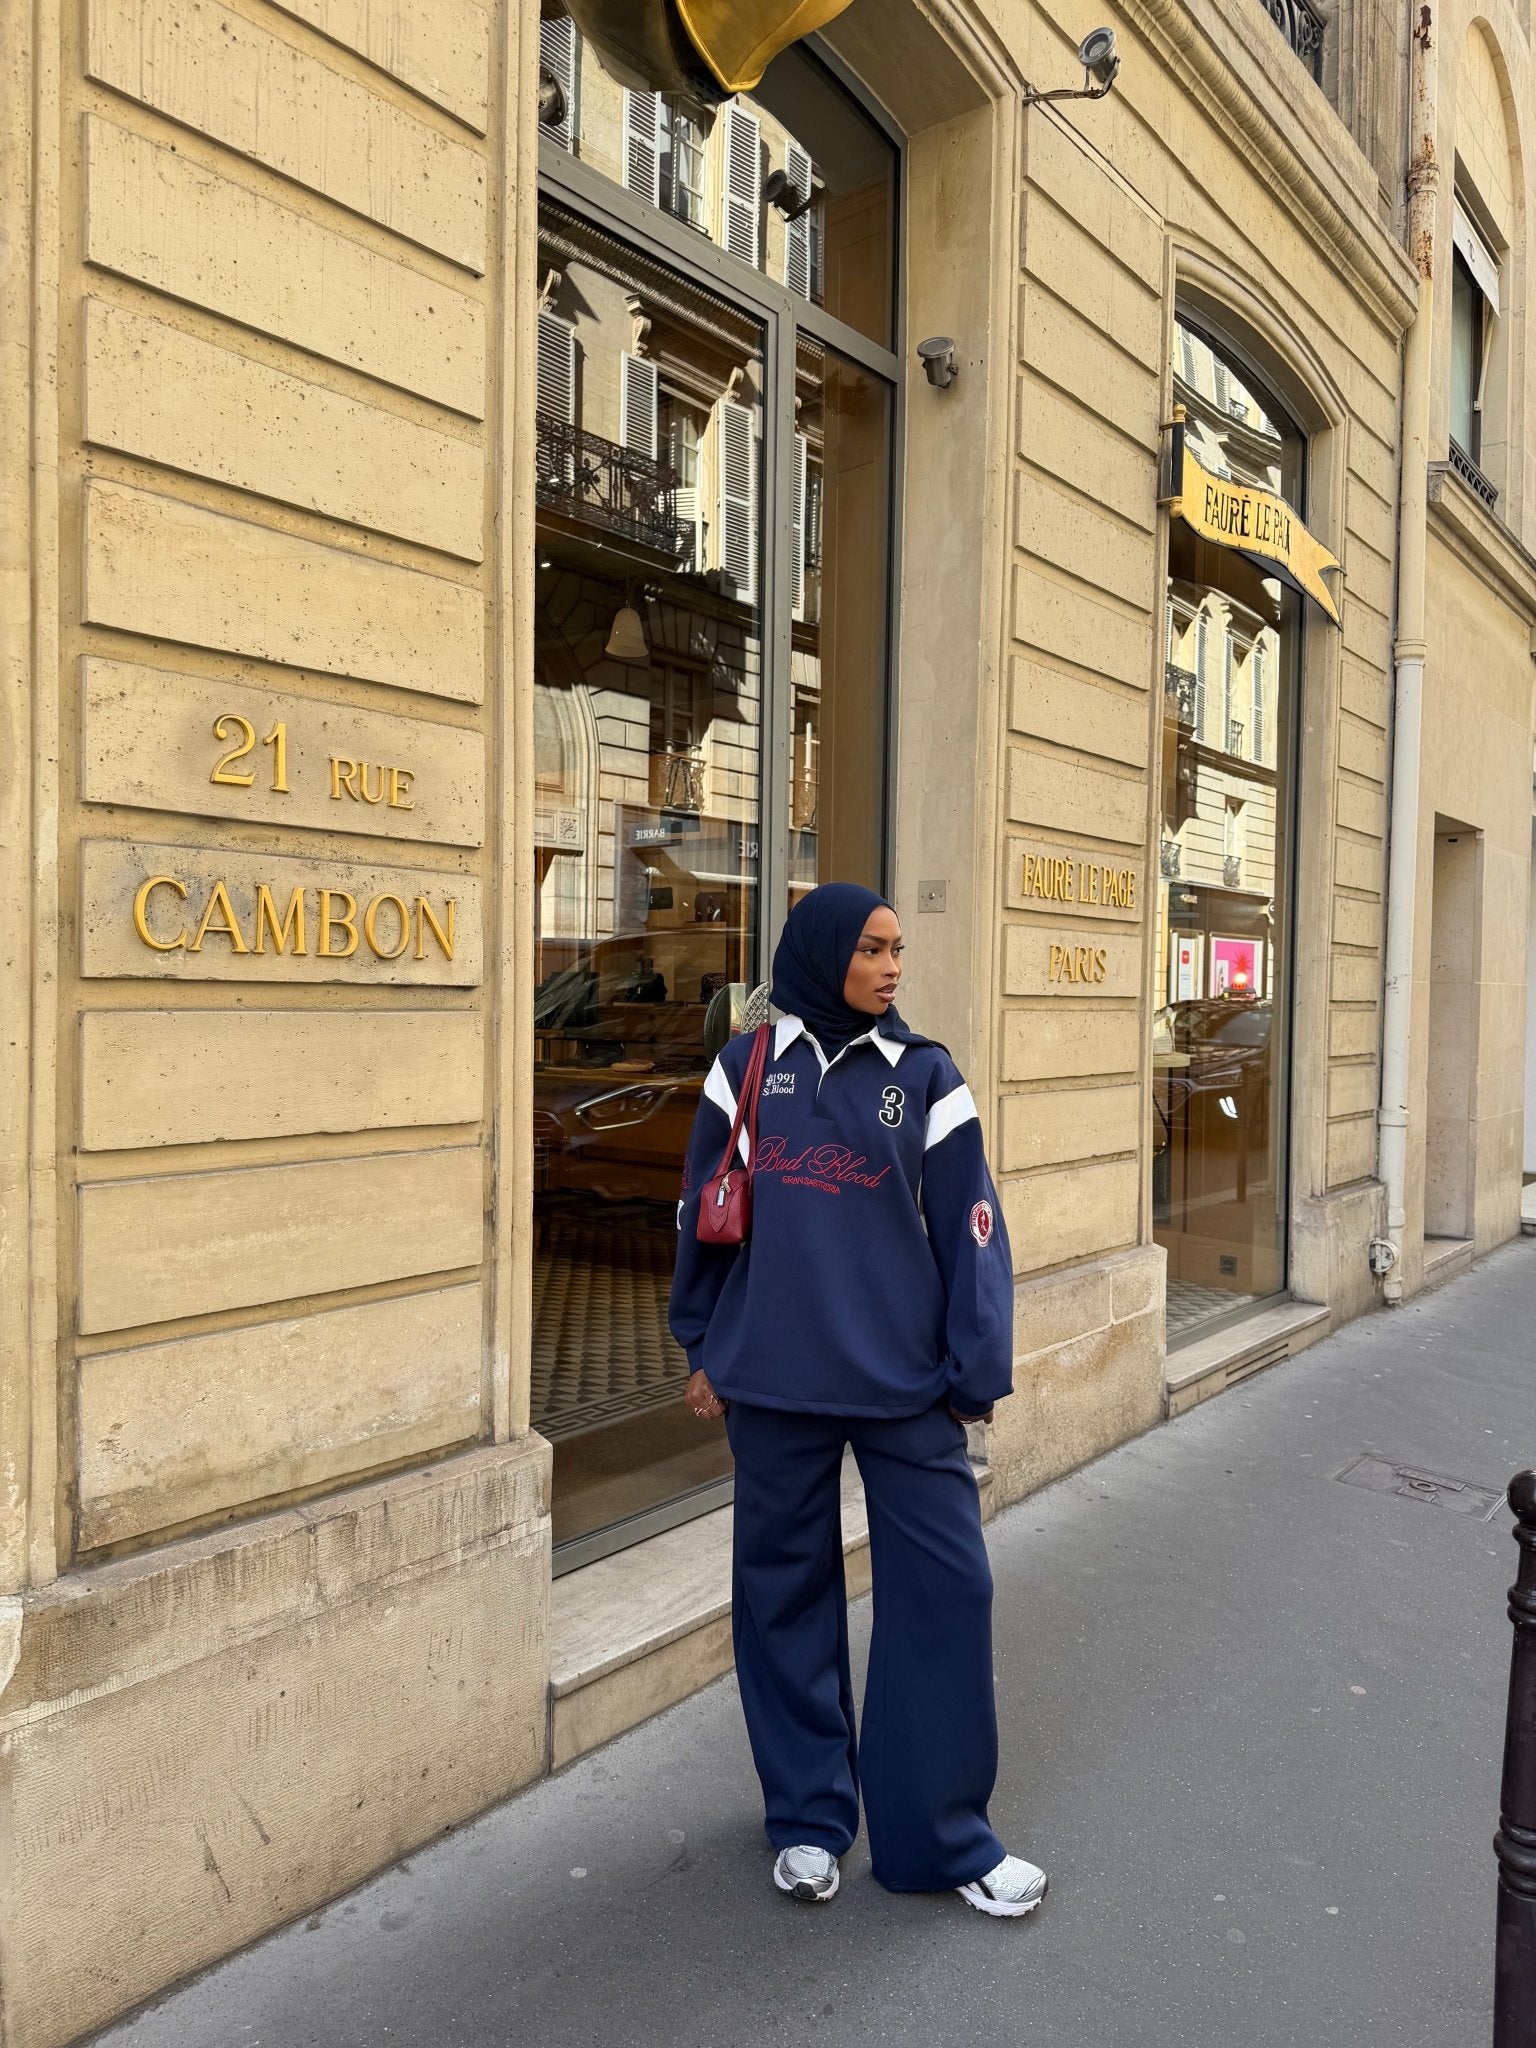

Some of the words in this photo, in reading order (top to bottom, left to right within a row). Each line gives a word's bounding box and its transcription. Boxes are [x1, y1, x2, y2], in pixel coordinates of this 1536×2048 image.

[1255, 502, 1271, 541] LE
[210, 713, 290, 794] 21
[329, 756, 416, 810] RUE
[1078, 863, 1099, 904] LE
[1101, 867, 1136, 909] PAGE
[133, 875, 457, 961] CAMBON
[1048, 944, 1107, 983] PARIS
[878, 1085, 905, 1128] 3
[753, 1135, 814, 1172] Bad
[807, 1144, 892, 1188] Blood
